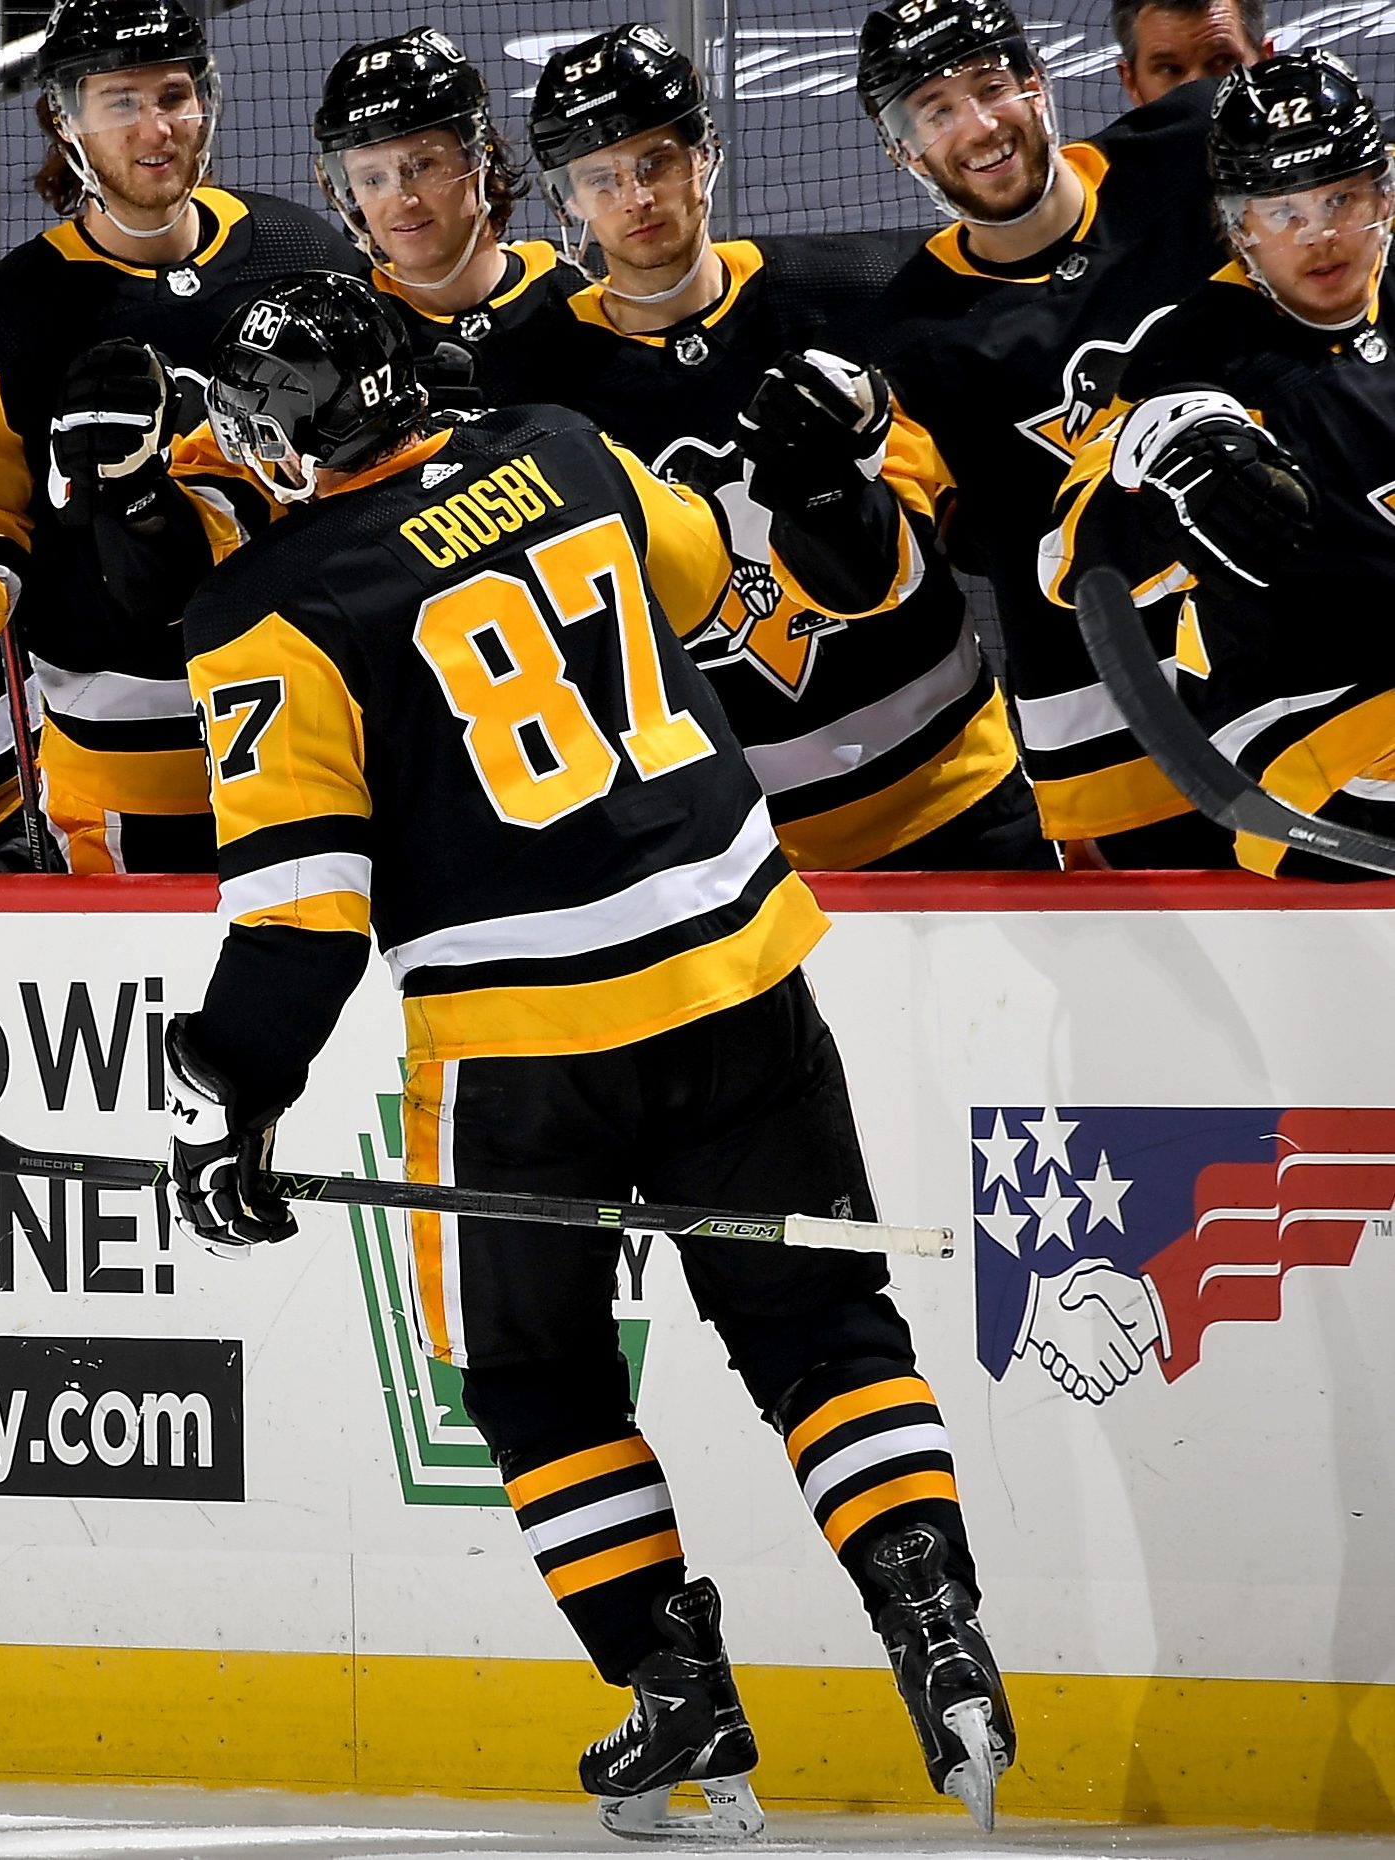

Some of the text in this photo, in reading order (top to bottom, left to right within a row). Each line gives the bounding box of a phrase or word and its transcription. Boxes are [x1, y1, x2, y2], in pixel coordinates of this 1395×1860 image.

[115, 23, 169, 40] CCM
[356, 51, 392, 75] 19
[564, 52, 602, 82] 53
[348, 98, 401, 122] CCM
[1266, 97, 1313, 128] 42
[1271, 142, 1334, 169] CCM
[244, 305, 281, 341] PPG
[359, 362, 394, 408] 87
[399, 454, 566, 569] CROSBY
[412, 513, 717, 829] 87
[194, 675, 286, 798] 7
[18, 976, 203, 1113] Wi
[709, 1220, 778, 1239] CCM
[1371, 1220, 1392, 1236] TM
[608, 1743, 644, 1778] CCM
[710, 1796, 737, 1804] CCM
